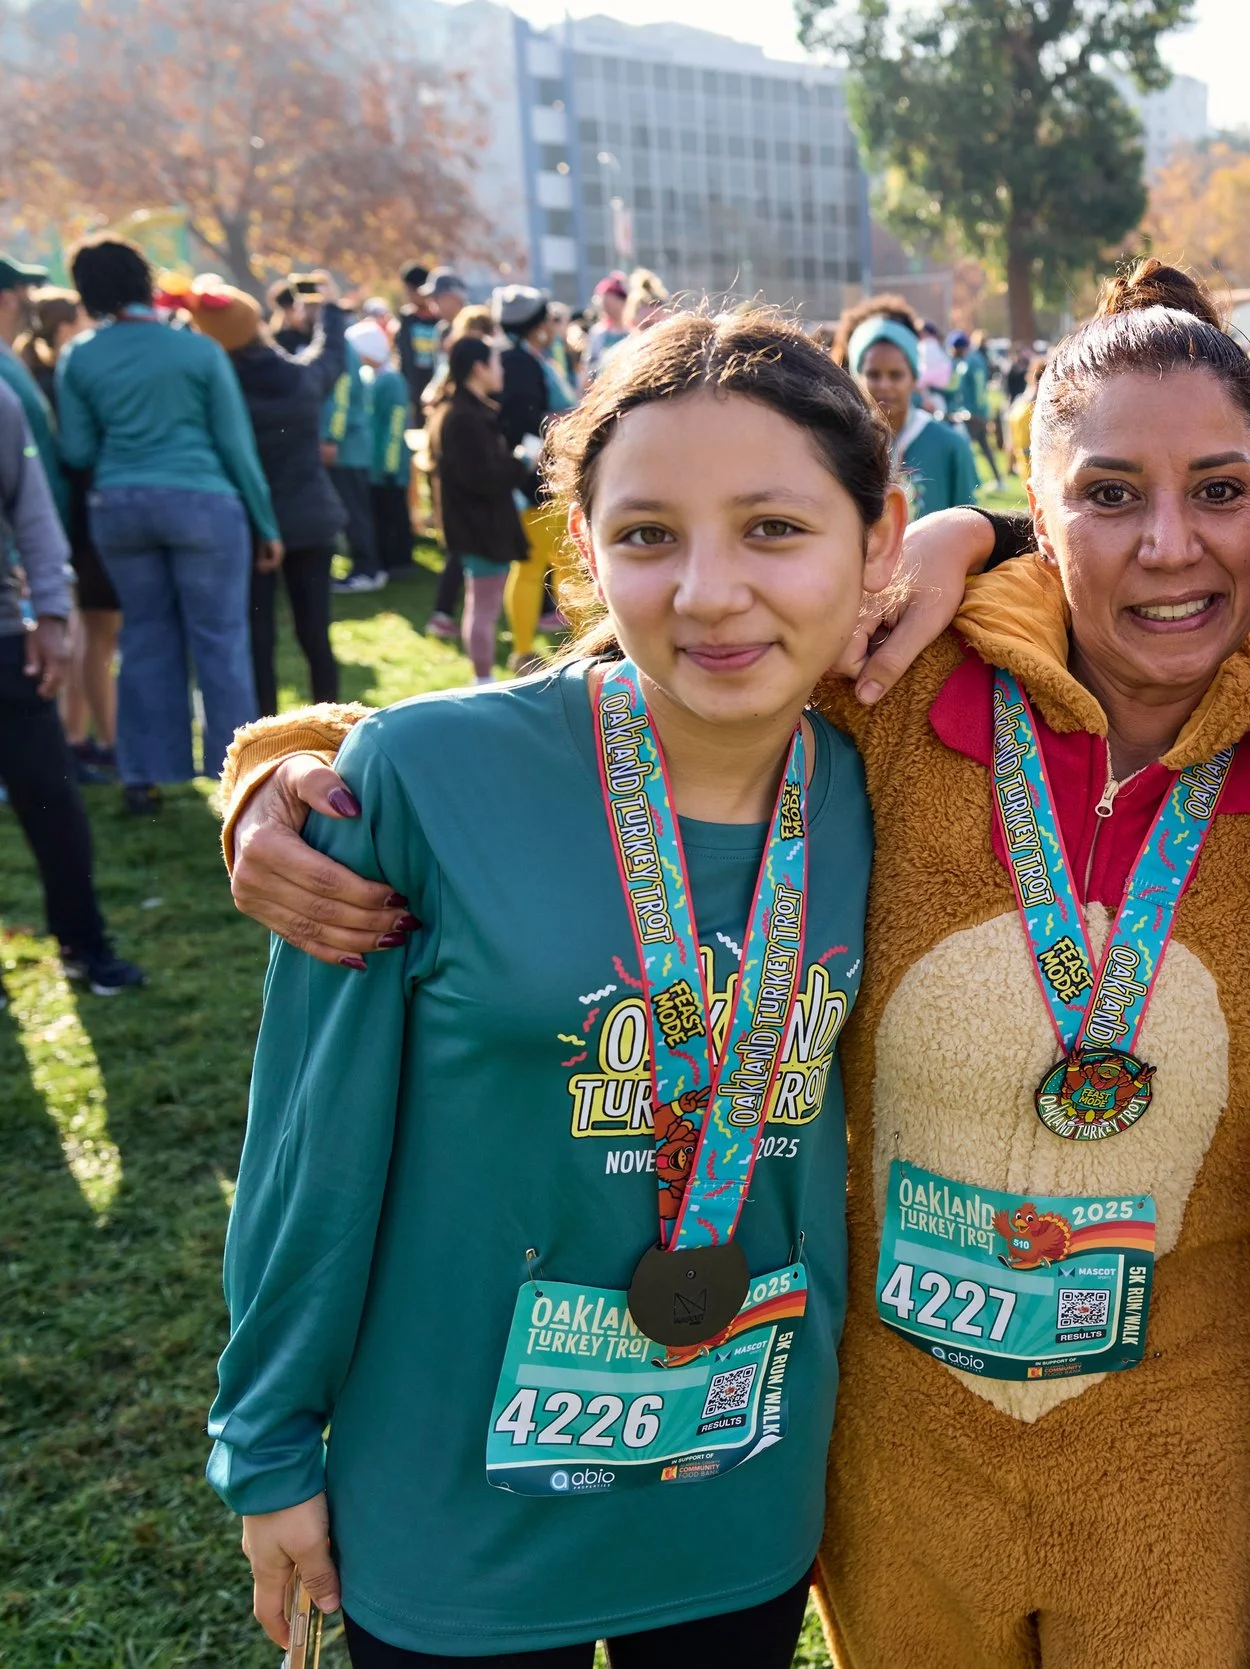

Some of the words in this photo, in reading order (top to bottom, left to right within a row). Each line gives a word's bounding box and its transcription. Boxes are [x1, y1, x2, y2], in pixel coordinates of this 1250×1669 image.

[600, 694, 650, 795] OAKLAND
[781, 782, 793, 840] FEAST
[791, 784, 804, 837] MODE
[998, 773, 1040, 851] TURKEY
[612, 793, 662, 881] TURKEY
[1015, 851, 1053, 907] TROT
[631, 883, 673, 943] TROT
[771, 885, 802, 942] TROT
[752, 943, 797, 1028] TURKEY
[1038, 950, 1080, 1002] MODE
[1056, 936, 1093, 991] FEAST
[605, 952, 845, 1073] OKND
[652, 991, 688, 1048] MODE
[670, 980, 704, 1038] FEAST
[1087, 947, 1147, 1043] OAKLAND
[575, 1078, 656, 1131] TUR
[774, 1060, 831, 1120] ROT
[718, 1029, 780, 1126] OAKLAND
[1079, 1096, 1107, 1108] MODE
[1082, 1088, 1111, 1100] FEAST
[1040, 1095, 1076, 1137] OAKLAND
[1075, 1119, 1119, 1139] TURKEY
[1118, 1097, 1147, 1125] TROT
[605, 1150, 657, 1175] NOVE
[757, 1136, 800, 1159] 2025
[899, 1178, 996, 1231] OAKLAND
[899, 1205, 954, 1239] TURKEY
[957, 1223, 996, 1255] TROT
[1072, 1200, 1134, 1226] 2025
[740, 1272, 791, 1310] 2025
[1078, 1267, 1117, 1276] MASCOT
[1129, 1266, 1146, 1284] 5K
[531, 1295, 645, 1337] OAKLAN
[881, 1262, 1017, 1343] 4227
[1121, 1286, 1145, 1345] RUN/WALK
[527, 1327, 605, 1358] TURKEY
[605, 1337, 652, 1363] TROT
[734, 1340, 768, 1356] MASCOT
[778, 1331, 794, 1353] 5K
[948, 1351, 985, 1370] abio
[1060, 1329, 1103, 1342] RESULTS
[1042, 1358, 1068, 1366] SUPPORT
[493, 1387, 665, 1449] 4226
[762, 1354, 789, 1438] RUN/WALK
[700, 1415, 743, 1434] RESULTS
[571, 1468, 615, 1486] abio
[678, 1454, 704, 1463] SUPPORT
[679, 1463, 720, 1473] COMMUNITY
